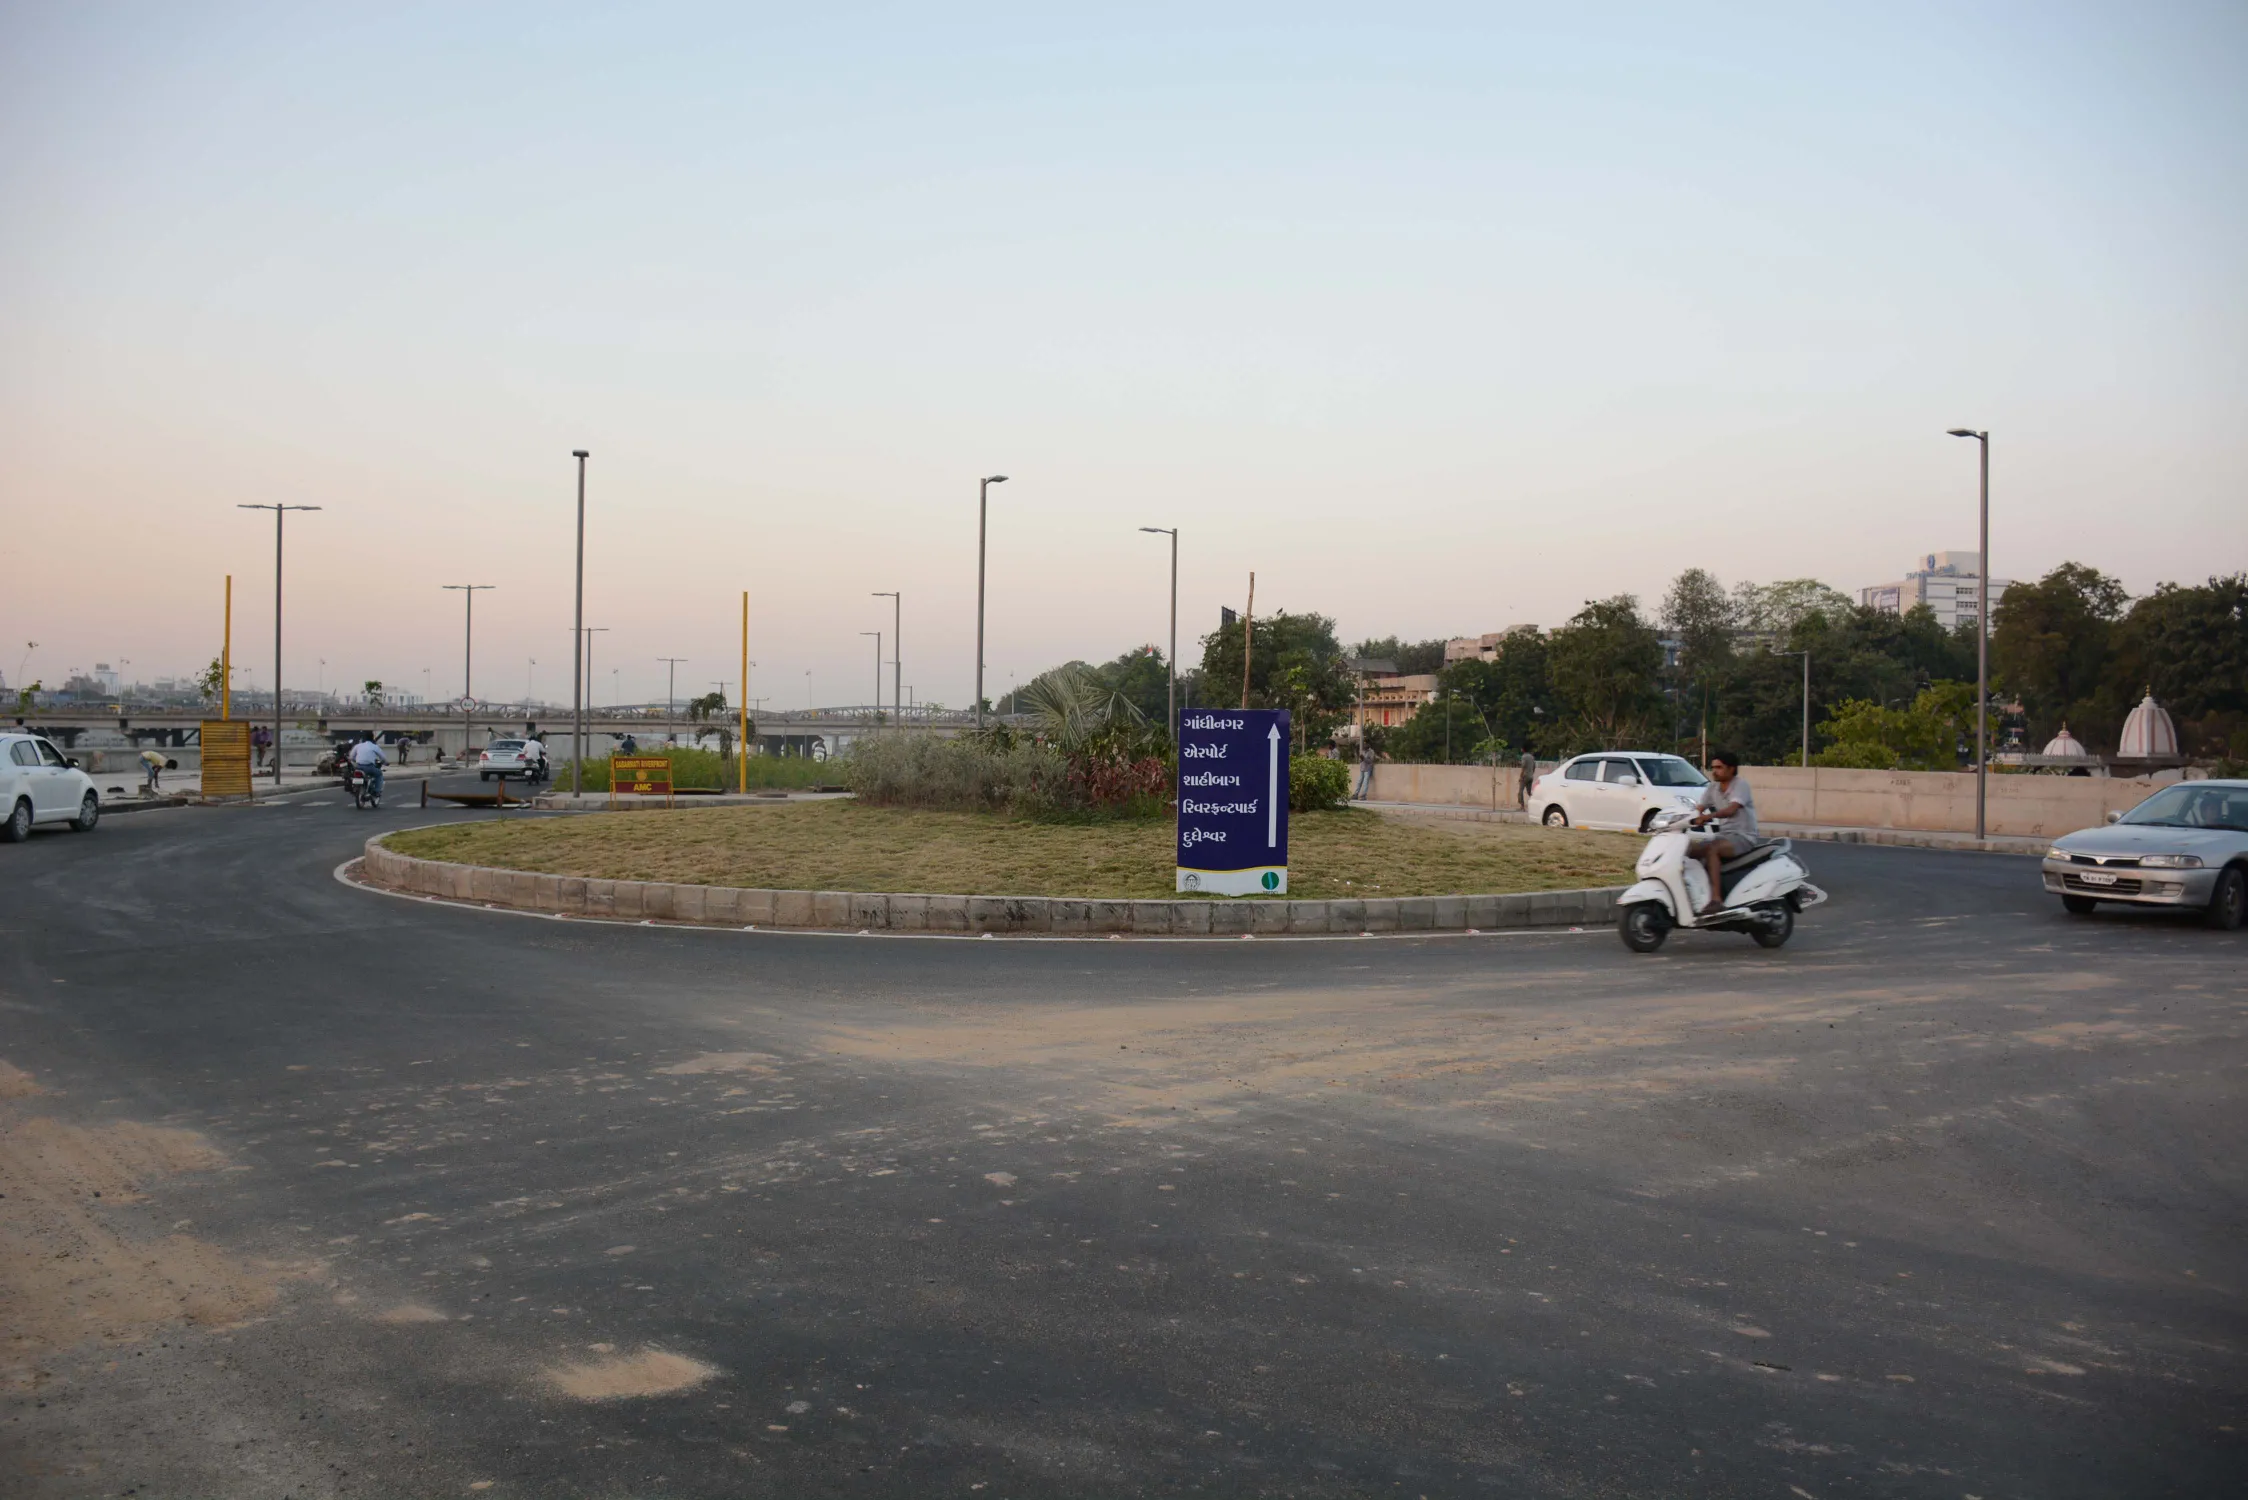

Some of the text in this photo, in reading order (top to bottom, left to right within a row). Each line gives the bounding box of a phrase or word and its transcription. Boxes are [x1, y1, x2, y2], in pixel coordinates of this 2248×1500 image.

[1183, 714, 1244, 730] ગાંધીનગર
[1183, 743, 1228, 758] એરપોર્ટ
[1183, 771, 1240, 786] શાહીબાગ
[633, 783, 652, 791] AMC
[1182, 827, 1227, 848] દુધેશ્વર
